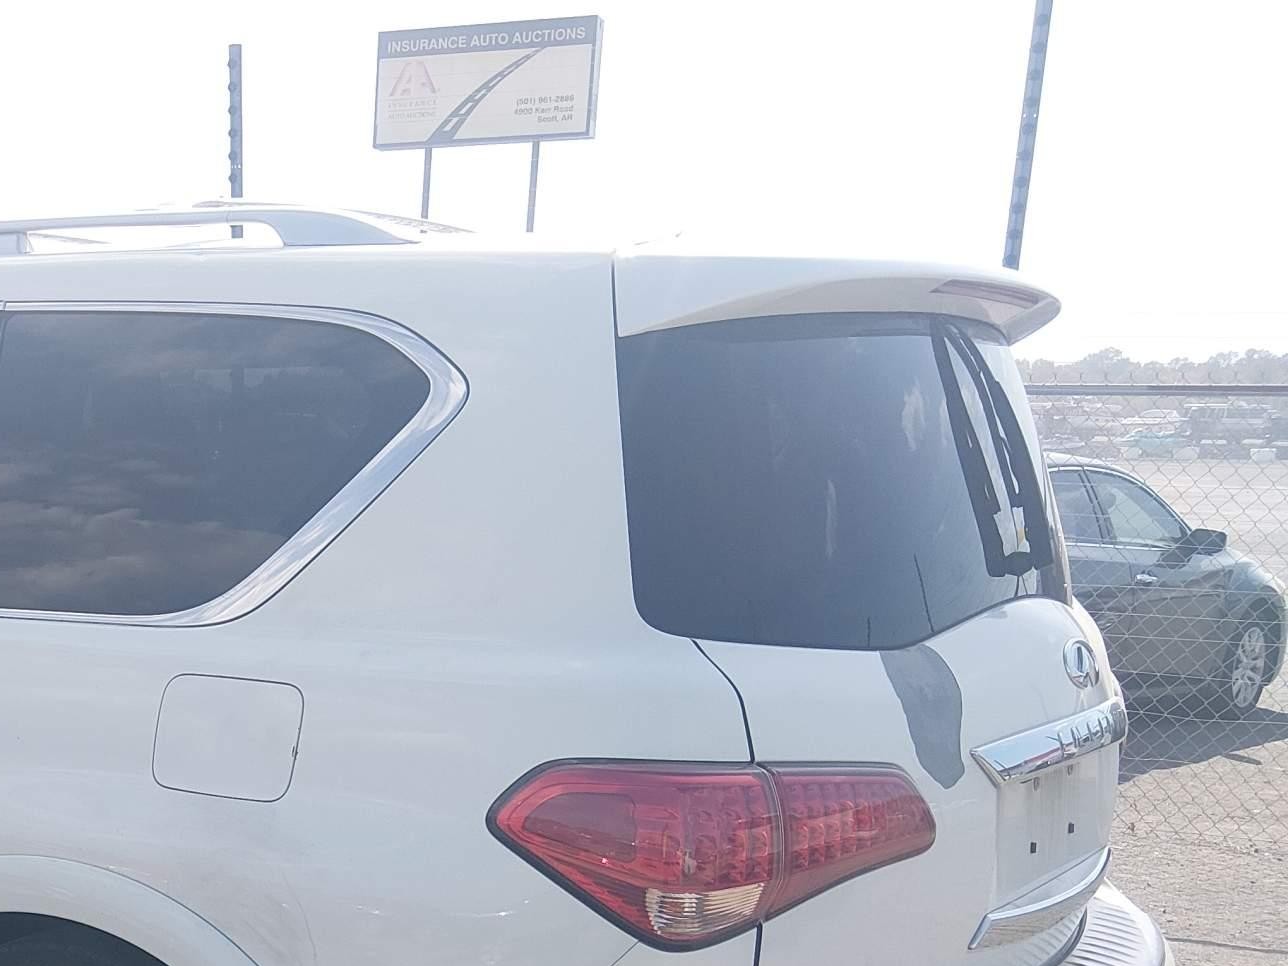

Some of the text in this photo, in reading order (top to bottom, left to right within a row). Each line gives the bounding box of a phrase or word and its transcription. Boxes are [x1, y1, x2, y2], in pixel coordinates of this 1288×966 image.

[387, 27, 586, 54] INSURANCE AUTO AUCTIONS
